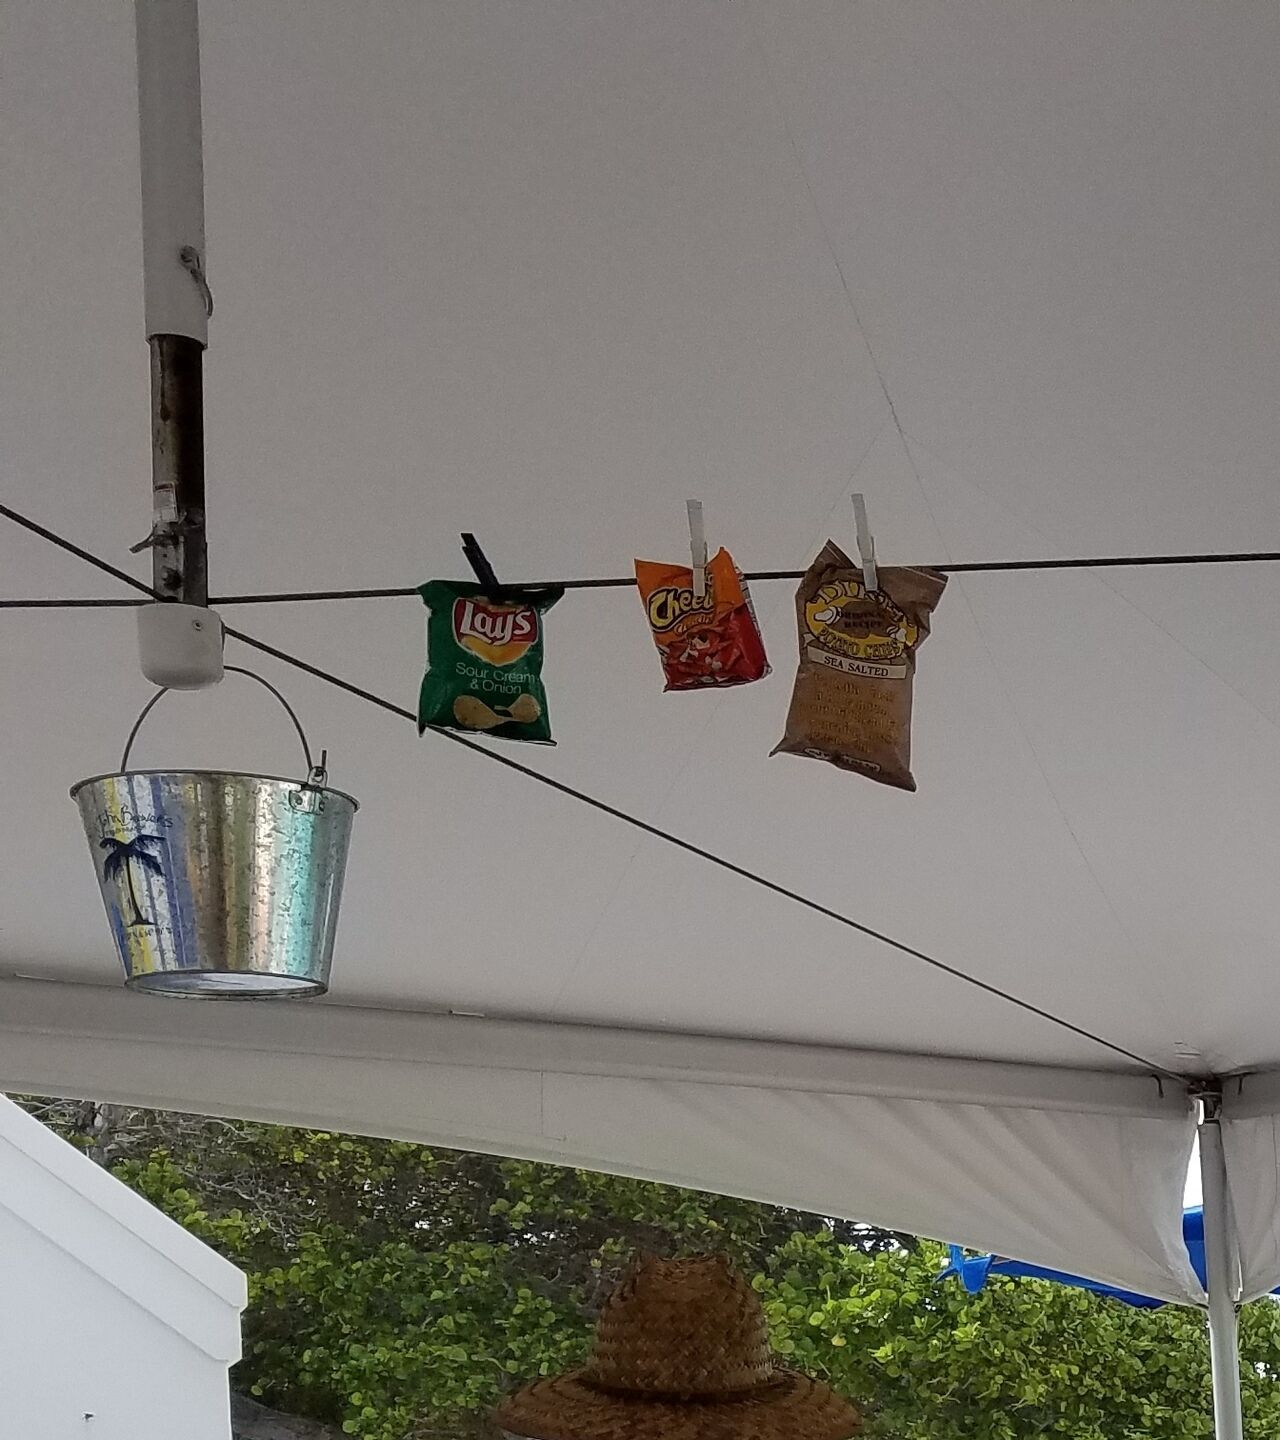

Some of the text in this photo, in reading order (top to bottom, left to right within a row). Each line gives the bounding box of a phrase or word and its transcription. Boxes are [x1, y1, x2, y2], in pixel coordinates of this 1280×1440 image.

[455, 662, 536, 683] Sour Cream
[824, 654, 889, 677] SEA SALTED
[470, 678, 522, 695] & Onion
